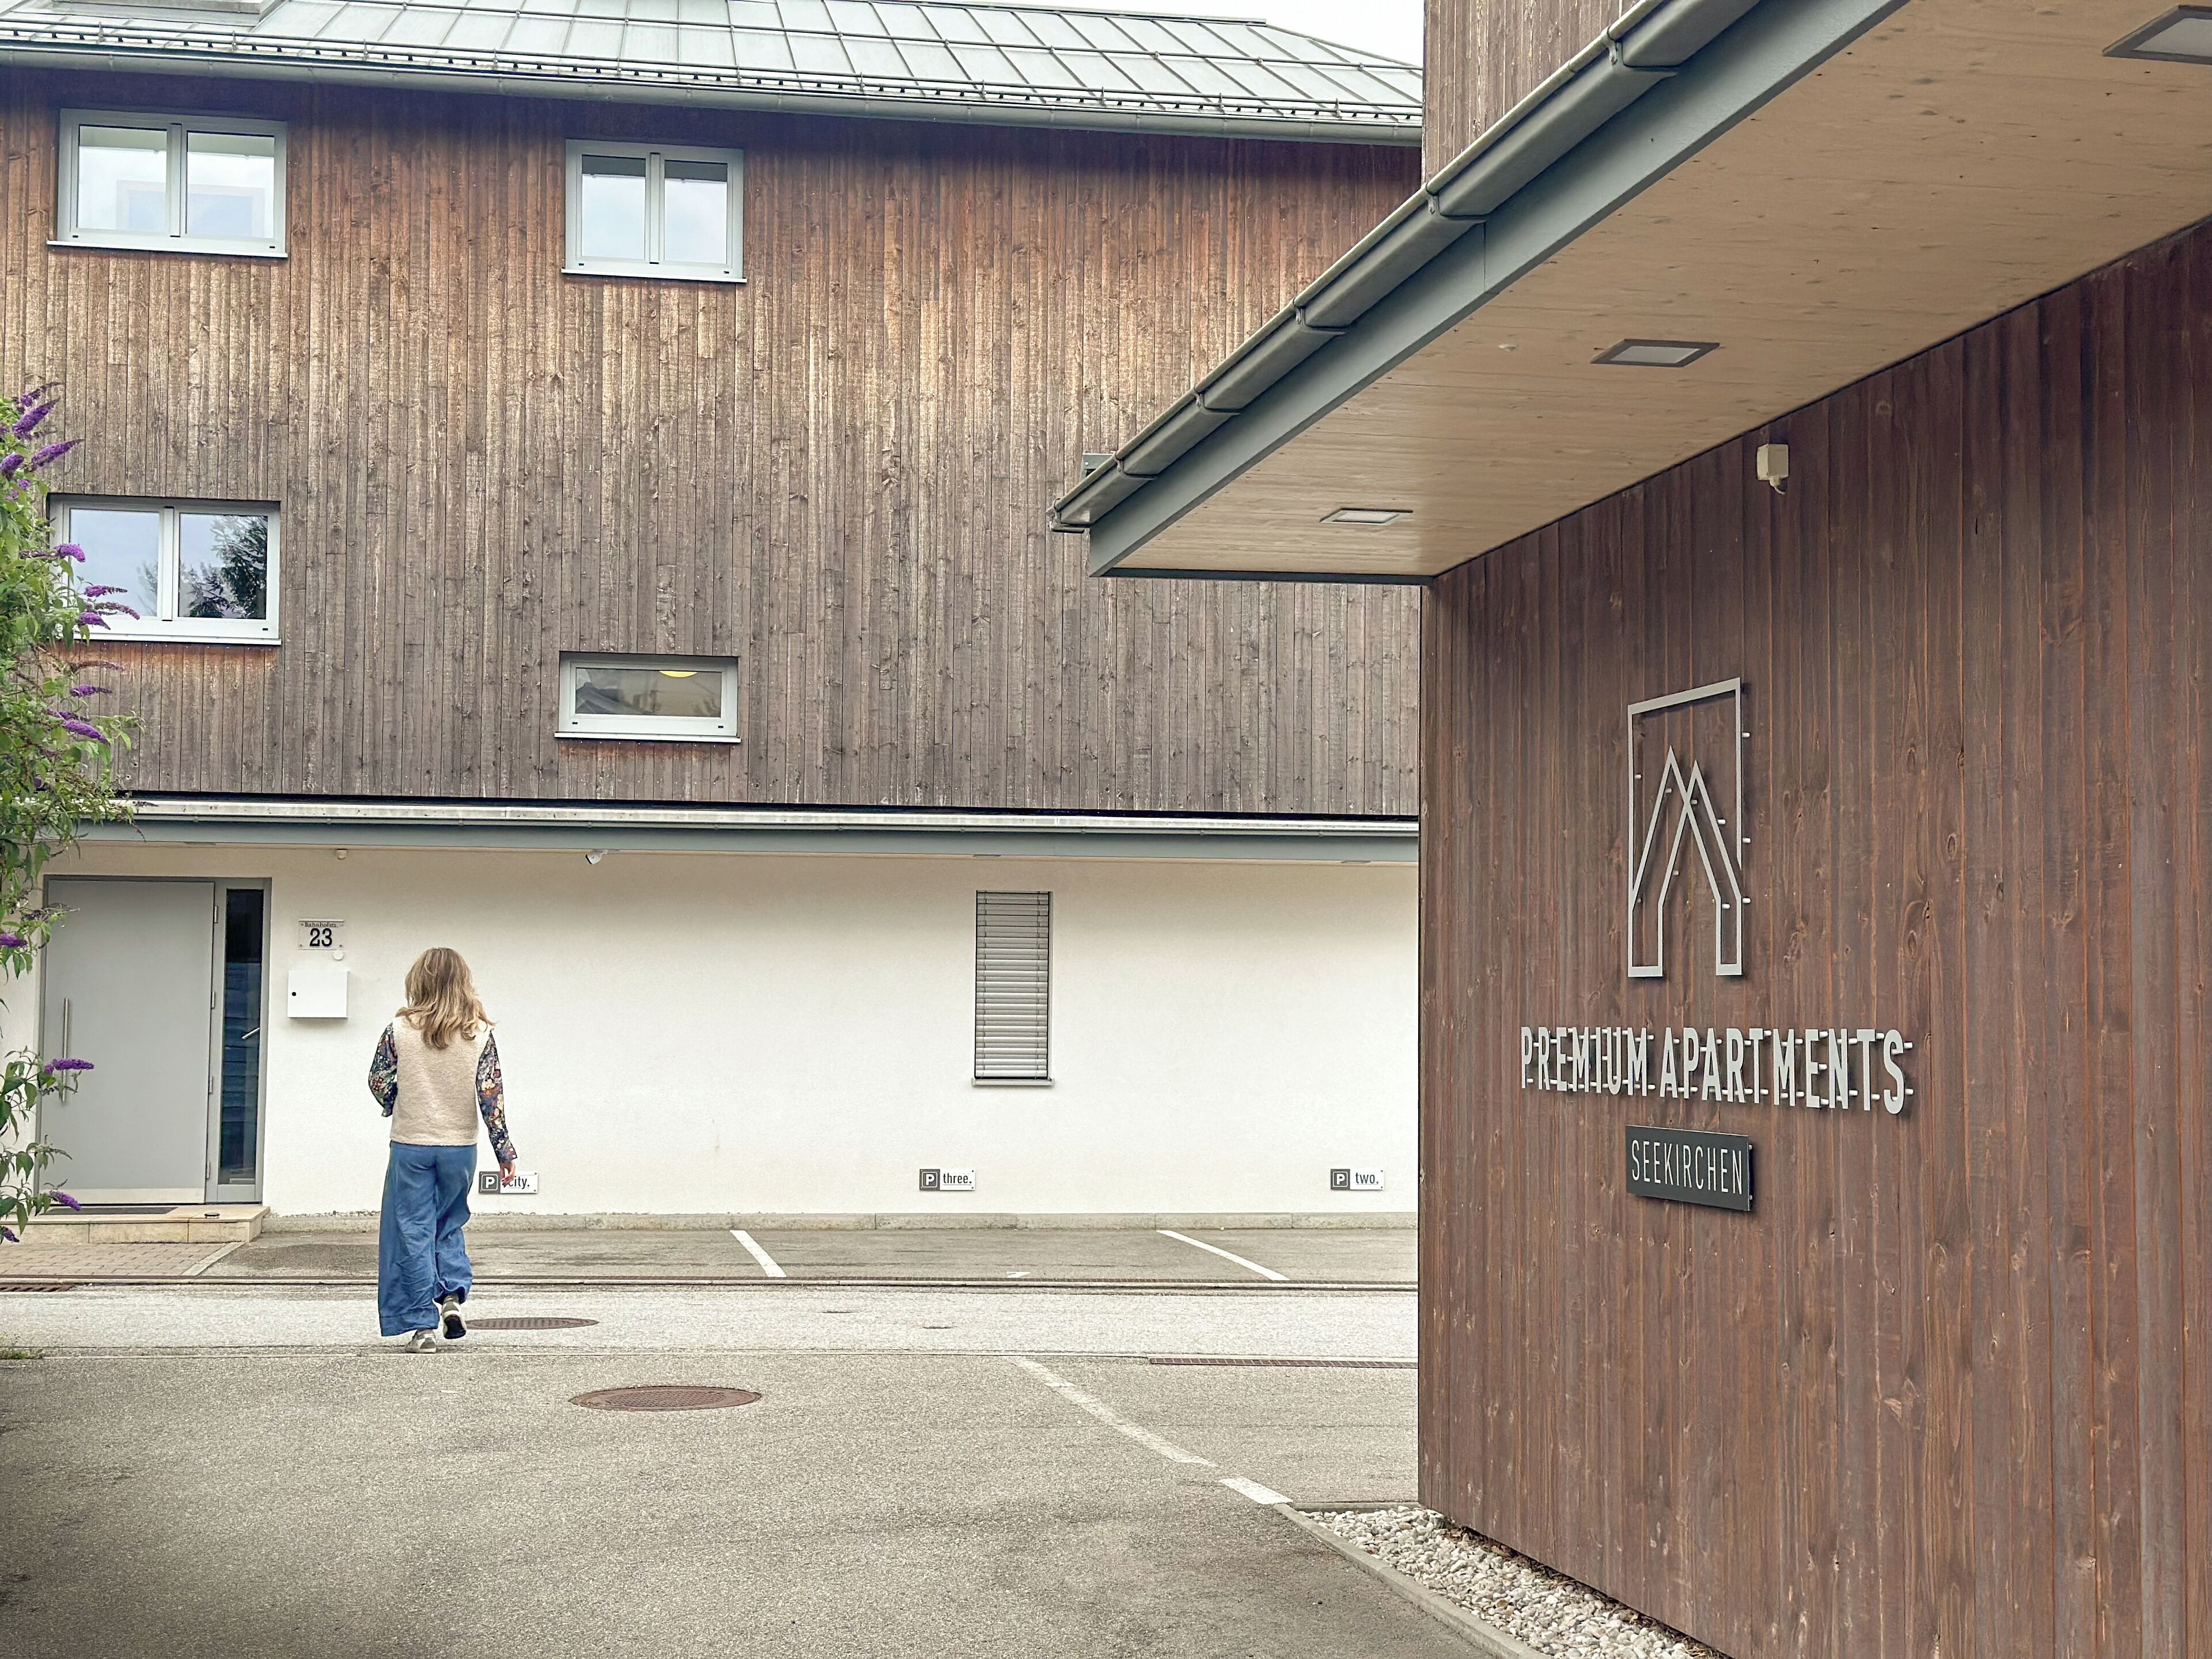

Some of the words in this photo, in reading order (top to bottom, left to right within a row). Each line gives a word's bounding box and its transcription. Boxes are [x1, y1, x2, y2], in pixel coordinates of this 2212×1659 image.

[309, 928, 332, 946] 23
[1520, 1026, 1648, 1096] PREMIUM
[1659, 1027, 1904, 1115] APARTMENTS
[1631, 1139, 1743, 1195] SEEKIRCHEN
[486, 1176, 495, 1188] P
[926, 1173, 935, 1185] P
[943, 1173, 972, 1183] three.
[1336, 1173, 1345, 1185] P
[1355, 1172, 1378, 1184] two.
